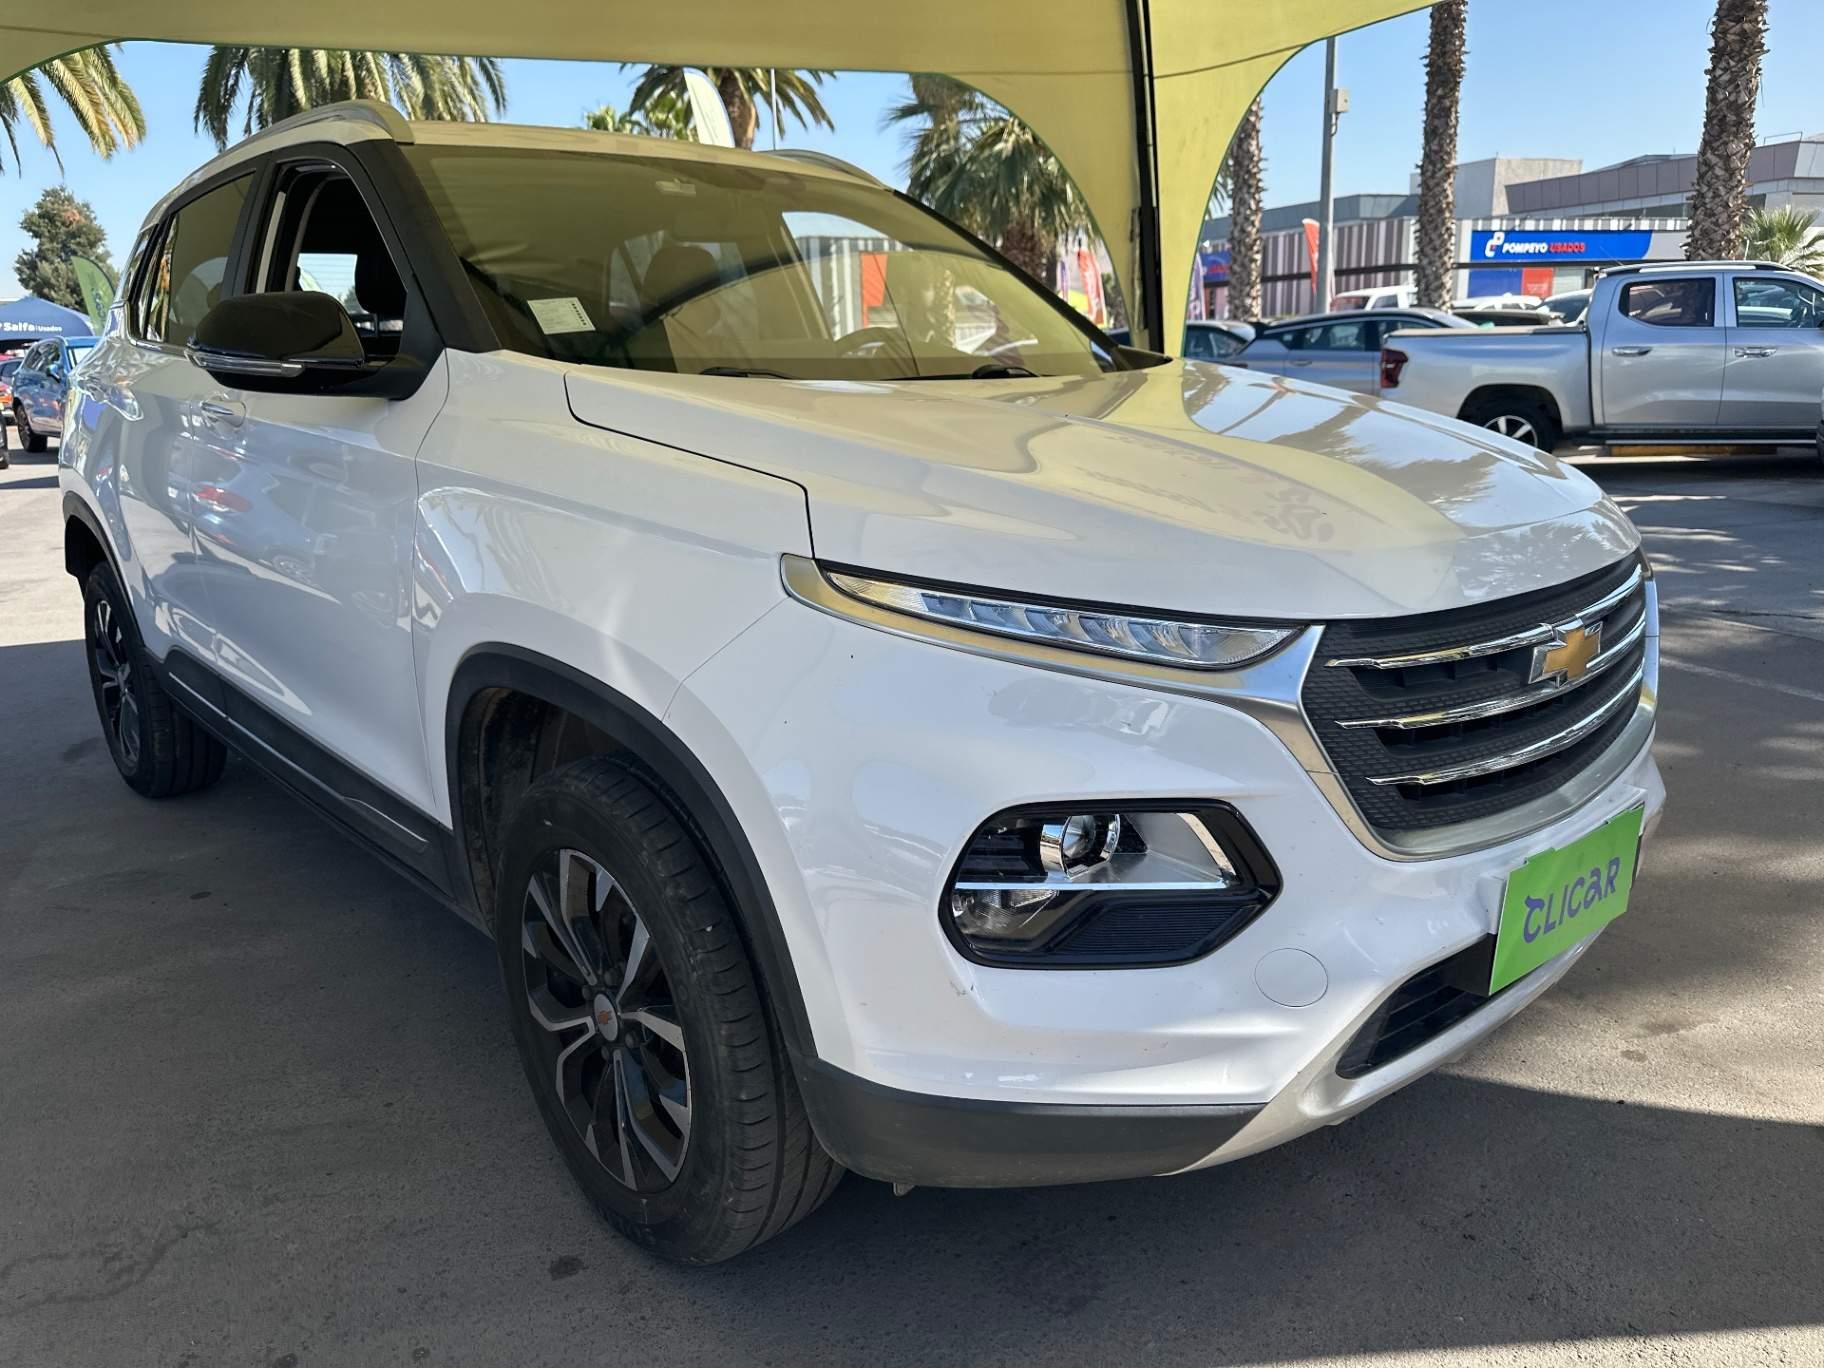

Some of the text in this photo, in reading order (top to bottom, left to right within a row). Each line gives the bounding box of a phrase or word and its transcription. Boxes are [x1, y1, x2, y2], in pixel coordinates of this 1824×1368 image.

[1502, 242, 1585, 254] POMPEYO USADOS
[3, 321, 35, 332] Salfa
